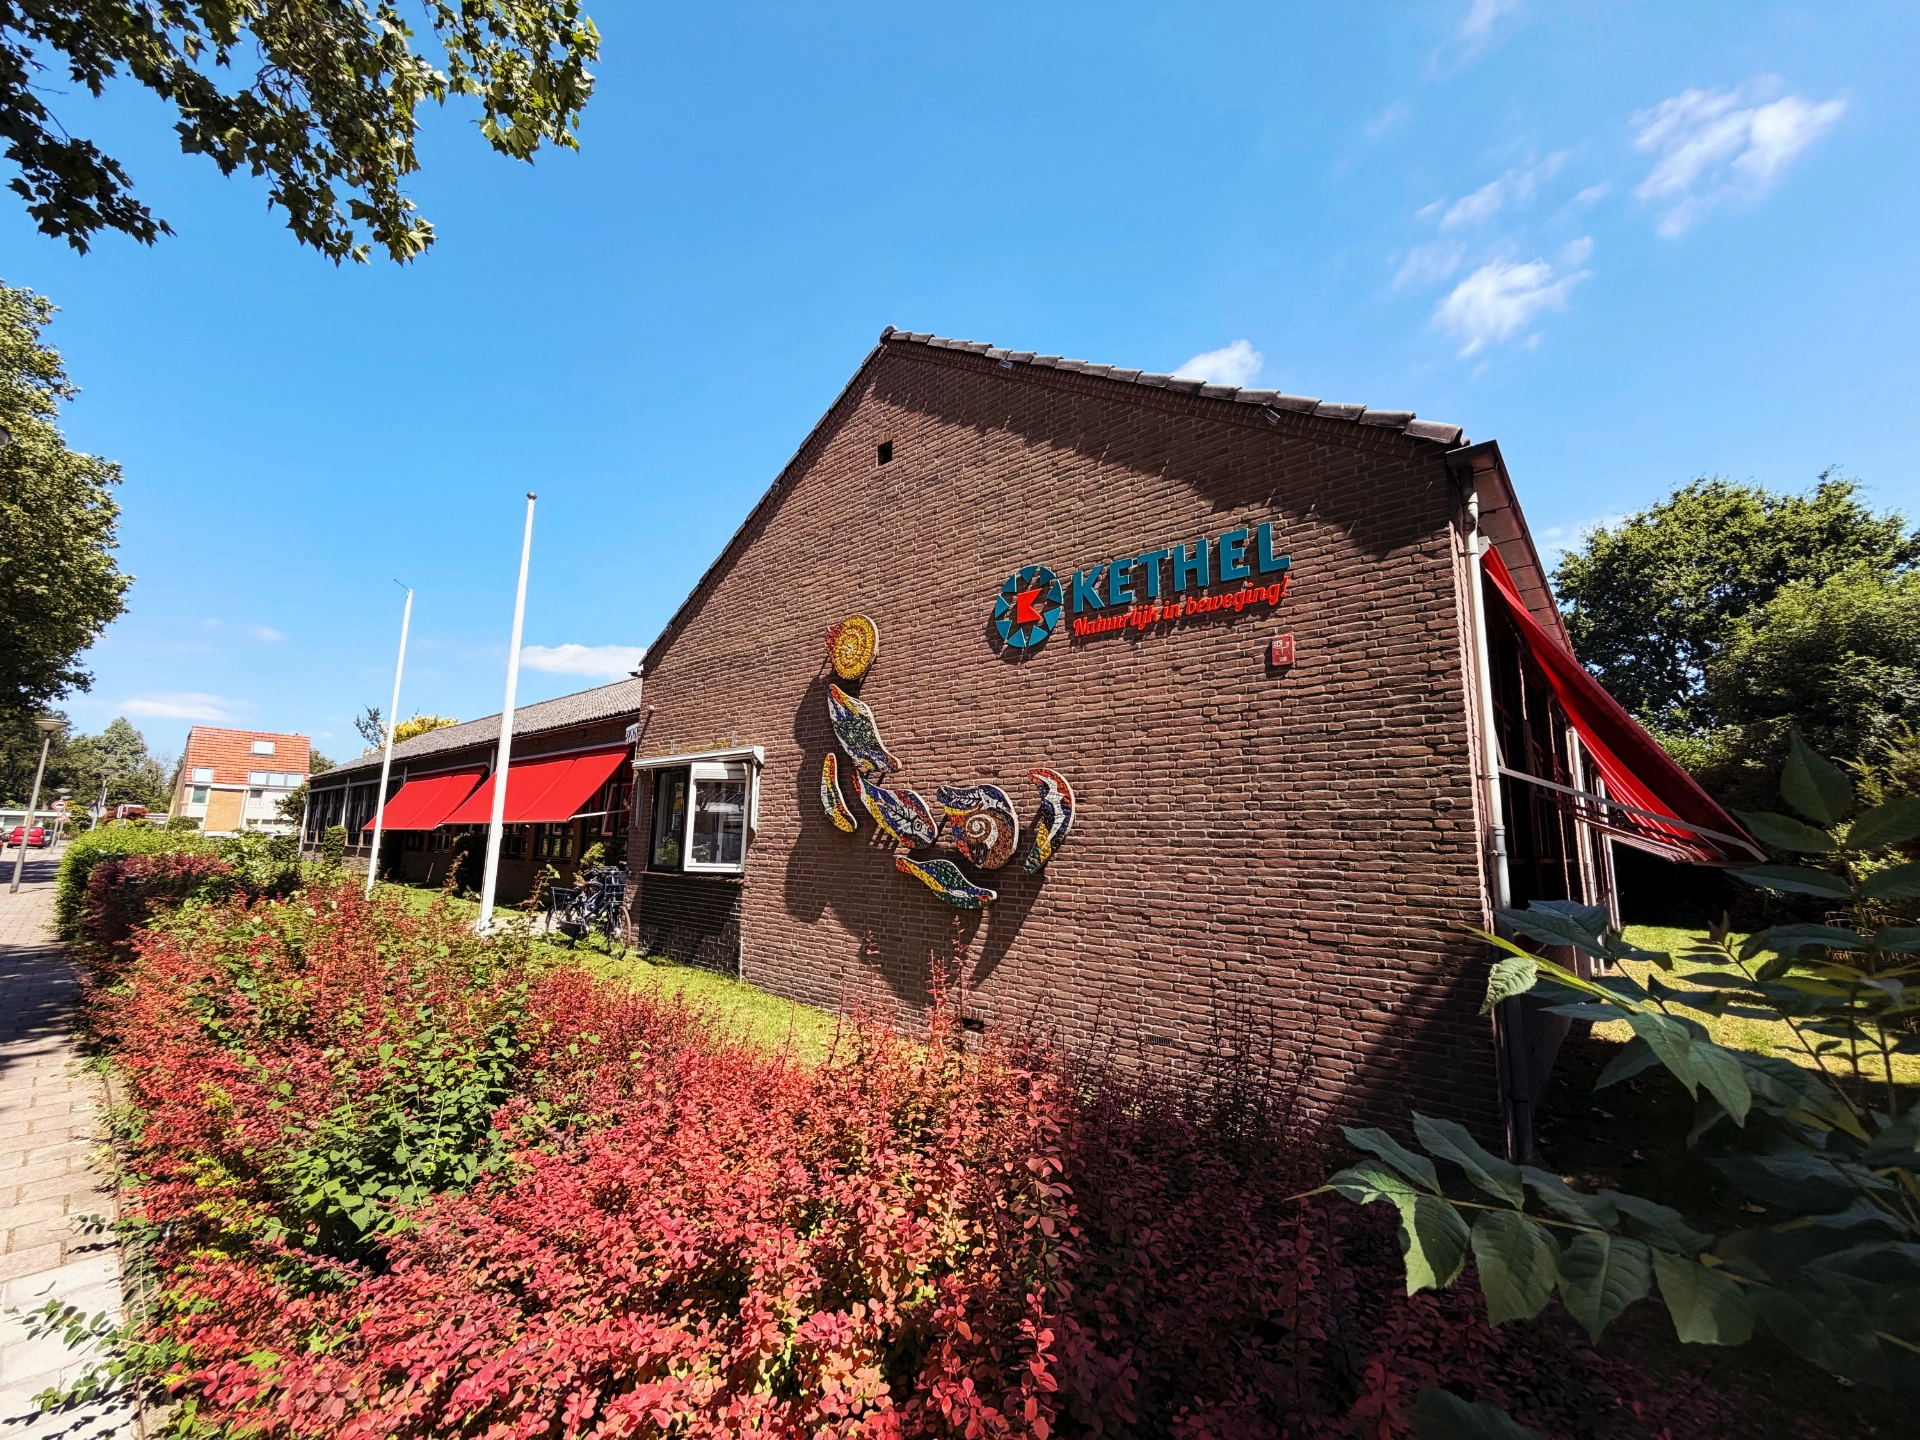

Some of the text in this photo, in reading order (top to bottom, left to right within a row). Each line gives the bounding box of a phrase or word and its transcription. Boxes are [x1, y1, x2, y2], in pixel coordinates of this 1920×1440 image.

[1073, 522, 1291, 614] KETHEL
[1073, 576, 1290, 637] Natuurlijk in beweging!
